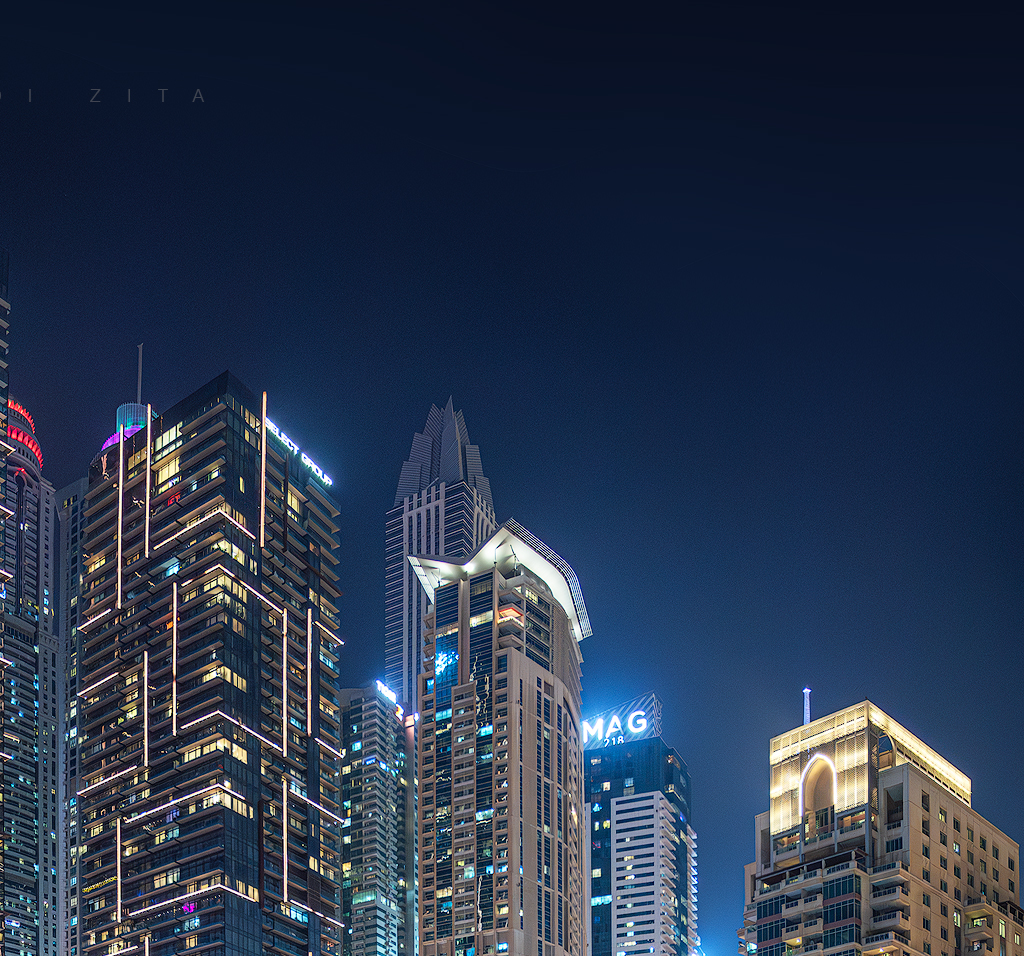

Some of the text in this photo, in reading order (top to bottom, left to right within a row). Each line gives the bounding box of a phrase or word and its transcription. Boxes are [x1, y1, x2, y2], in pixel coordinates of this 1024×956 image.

[301, 452, 334, 486] GROUP
[582, 710, 648, 744] MAG
[604, 735, 625, 747] 218
